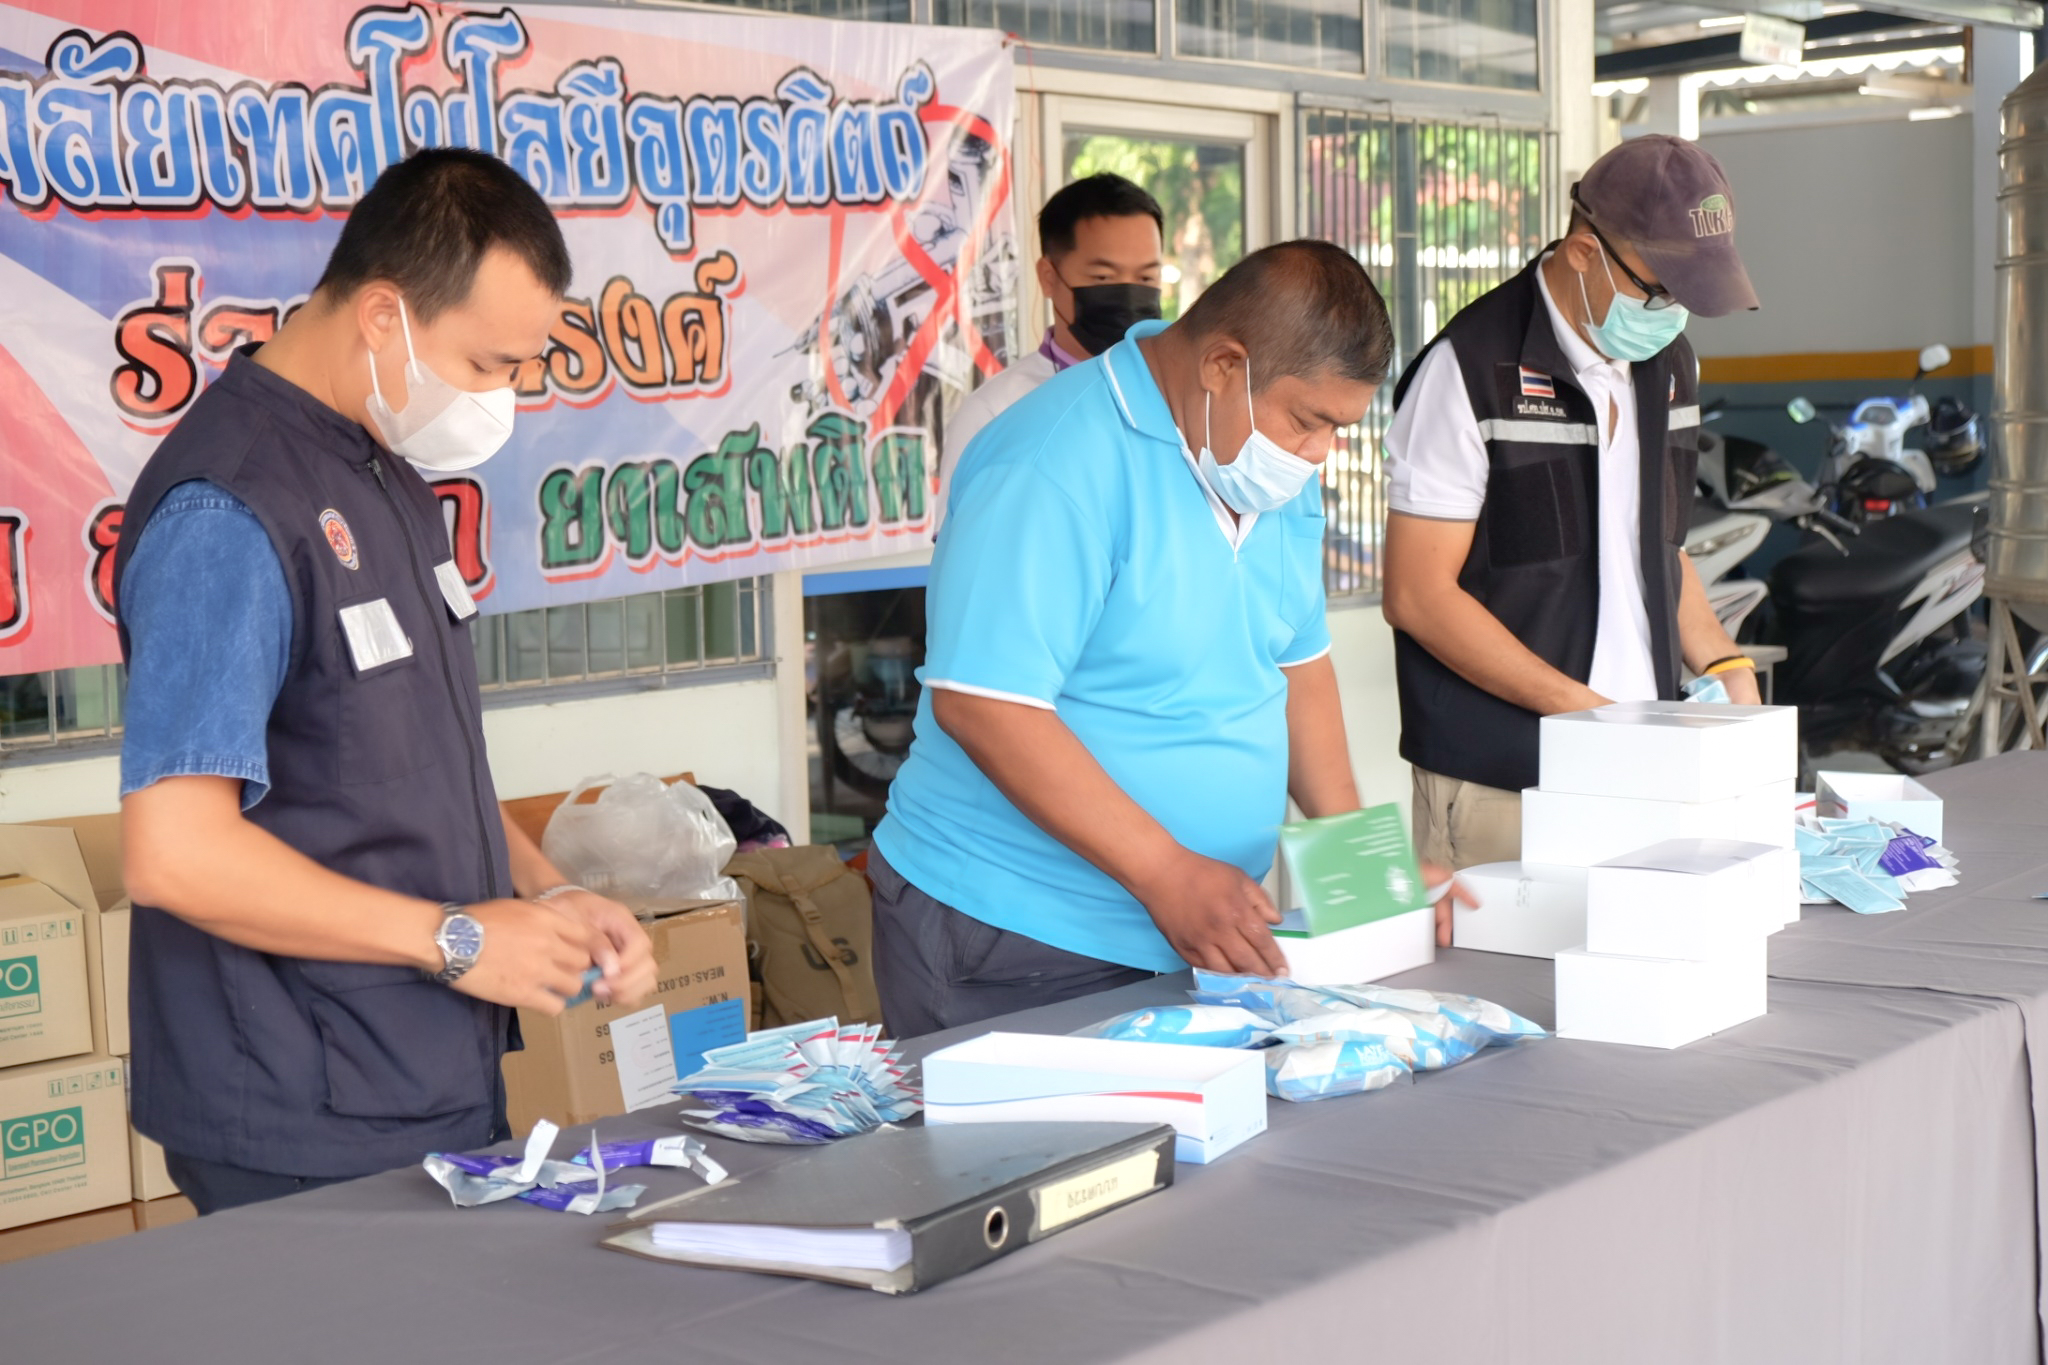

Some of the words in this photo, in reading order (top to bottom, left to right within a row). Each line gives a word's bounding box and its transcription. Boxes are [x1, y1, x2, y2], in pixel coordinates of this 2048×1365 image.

[541, 412, 928, 569] ยาเสพติด
[692, 966, 726, 983] MEAS:
[6, 1114, 78, 1152] GPO
